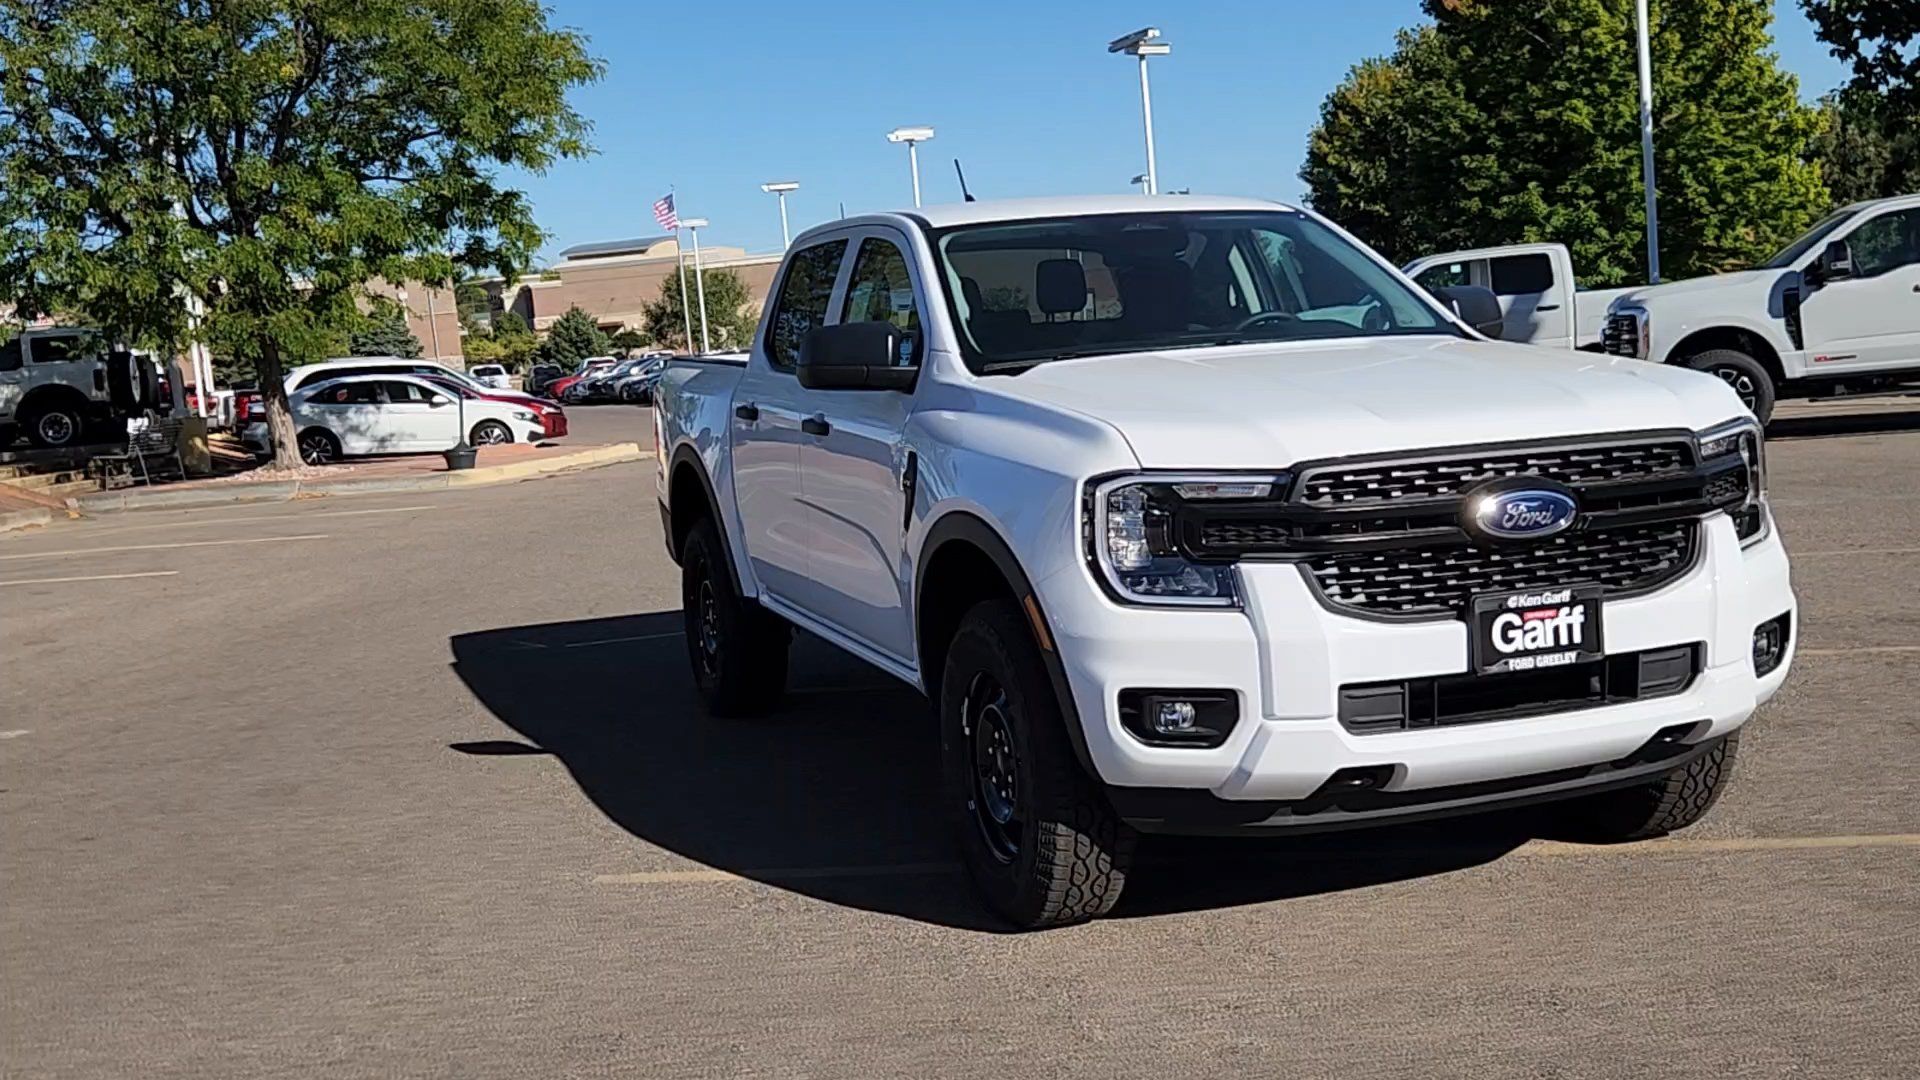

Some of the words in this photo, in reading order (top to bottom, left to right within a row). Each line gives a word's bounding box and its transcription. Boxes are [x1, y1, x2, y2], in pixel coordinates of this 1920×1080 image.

[1503, 501, 1553, 528] Ford
[1519, 594, 1541, 607] Ken
[1542, 589, 1571, 604] Garff
[1492, 605, 1585, 653] Garff
[1509, 657, 1534, 671] FORD
[1536, 652, 1577, 667] GREELEY
